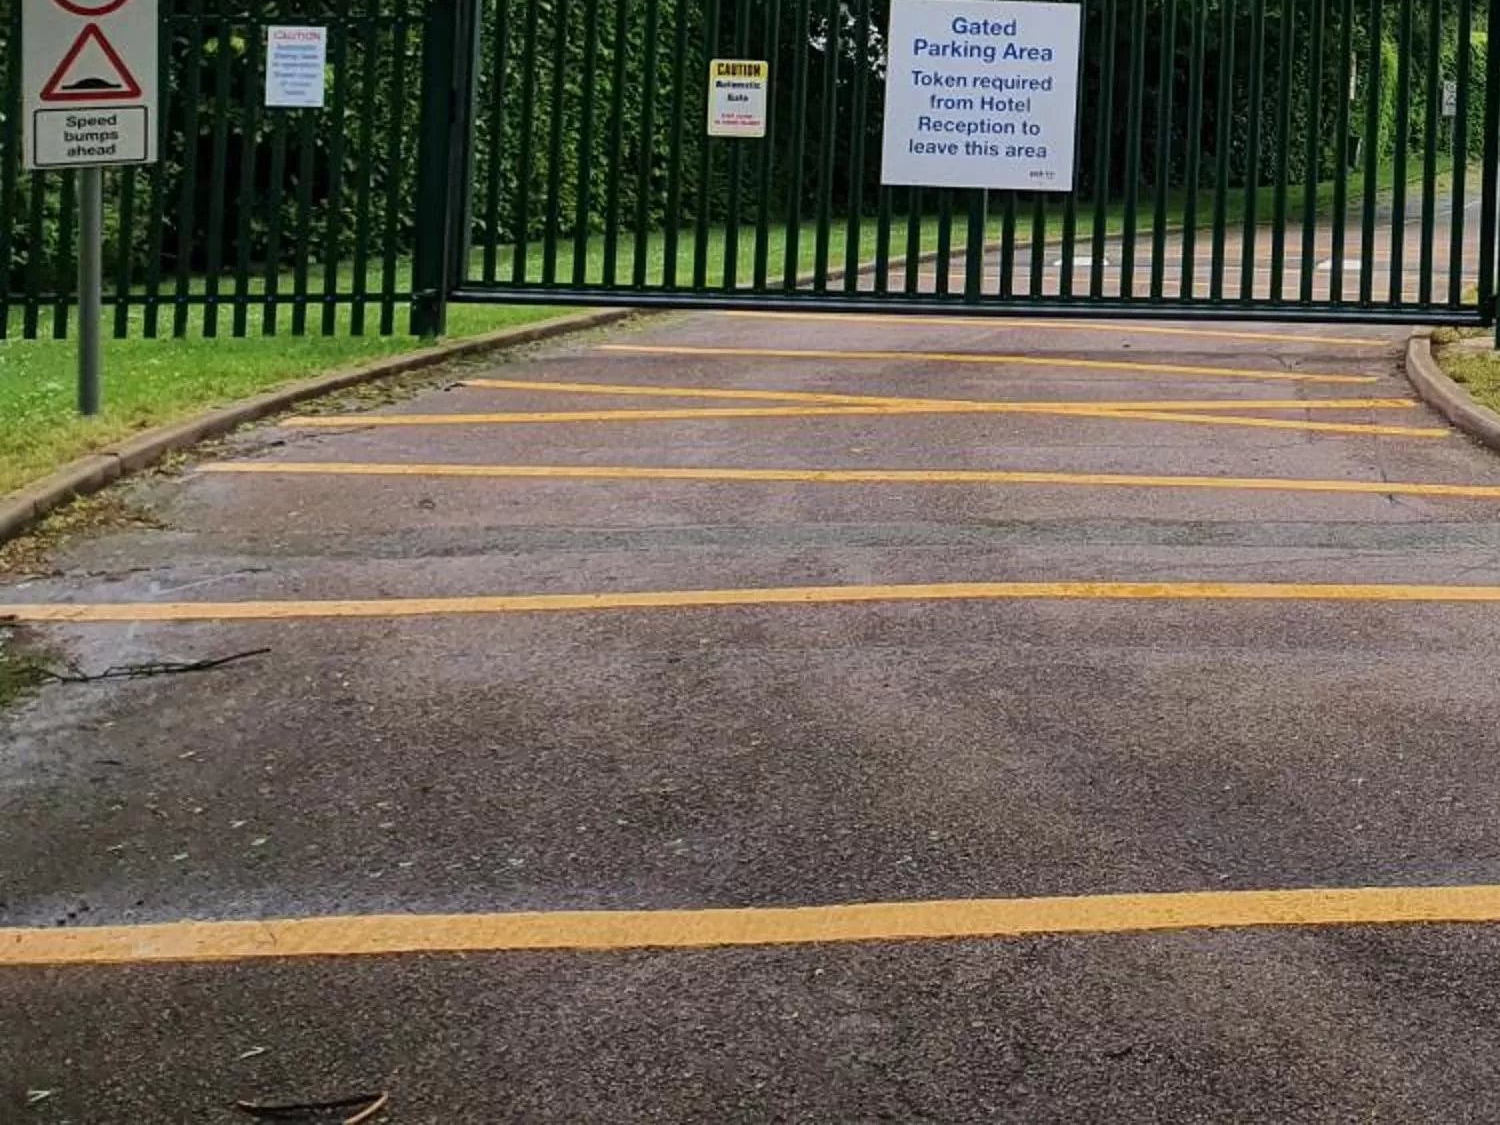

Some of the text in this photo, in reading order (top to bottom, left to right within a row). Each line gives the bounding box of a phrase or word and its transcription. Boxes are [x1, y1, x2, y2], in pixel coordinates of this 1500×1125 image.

[951, 17, 1017, 36] Gated
[913, 39, 1053, 63] Parking Area
[717, 63, 761, 77] CAUTION
[912, 70, 1053, 92] Token required
[930, 94, 1031, 112] from Hotel
[65, 114, 117, 130] Speed
[917, 116, 1041, 136] Reception to
[63, 130, 119, 145] bumps
[66, 143, 116, 157] ahead
[909, 139, 1047, 159] leave this area
